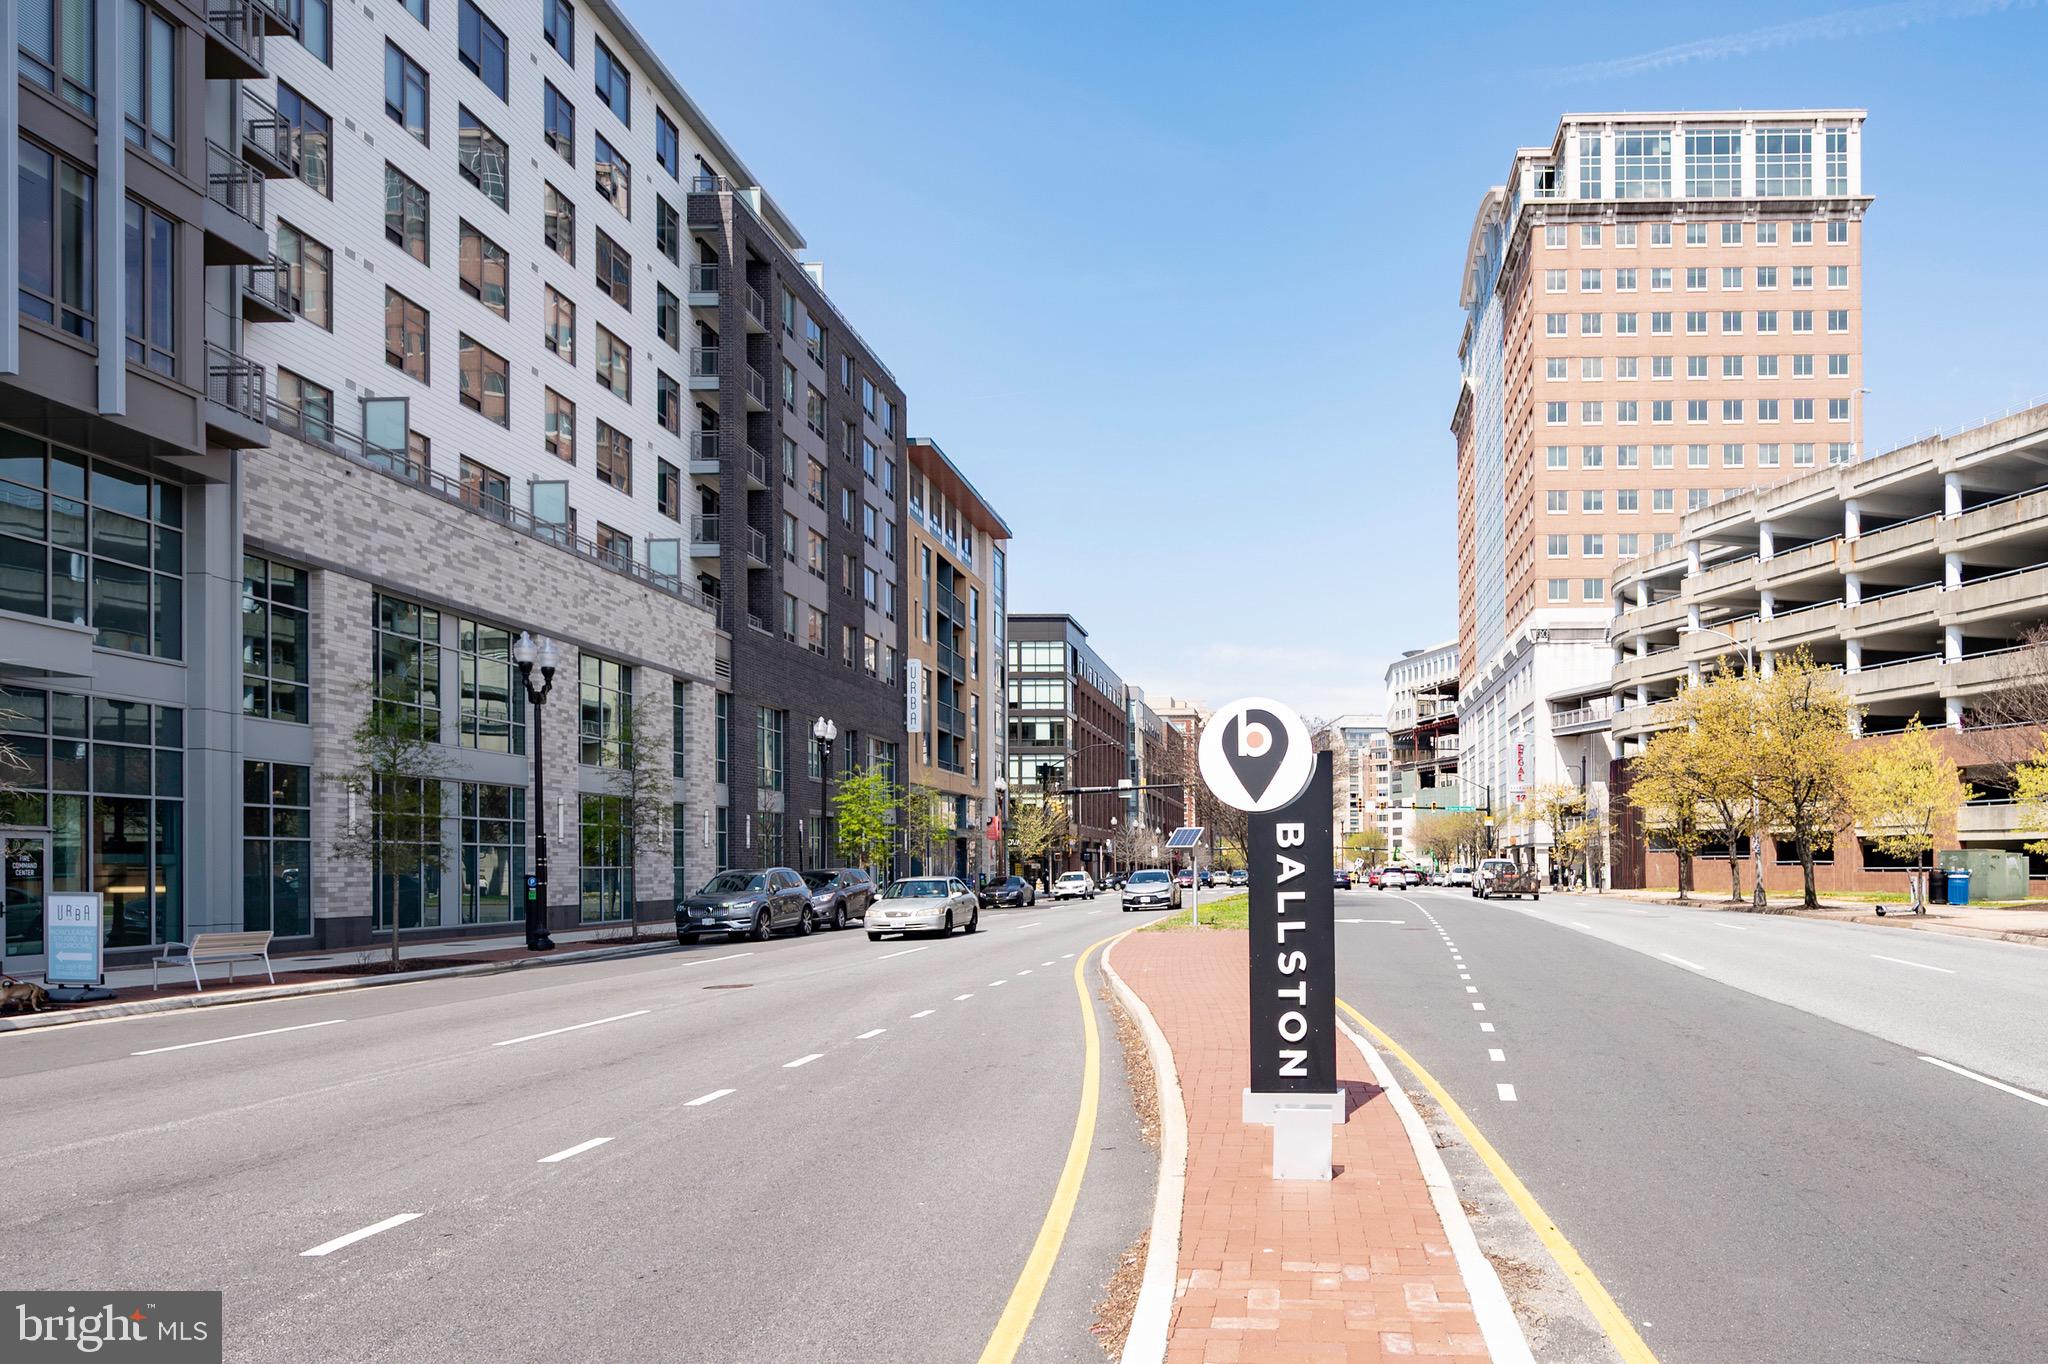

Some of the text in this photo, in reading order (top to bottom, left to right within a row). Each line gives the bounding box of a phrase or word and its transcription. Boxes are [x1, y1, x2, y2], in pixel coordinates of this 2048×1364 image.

[1517, 744, 1526, 782] REGAL
[57, 904, 90, 921] URBA
[1275, 822, 1308, 1077] BALLSTON
